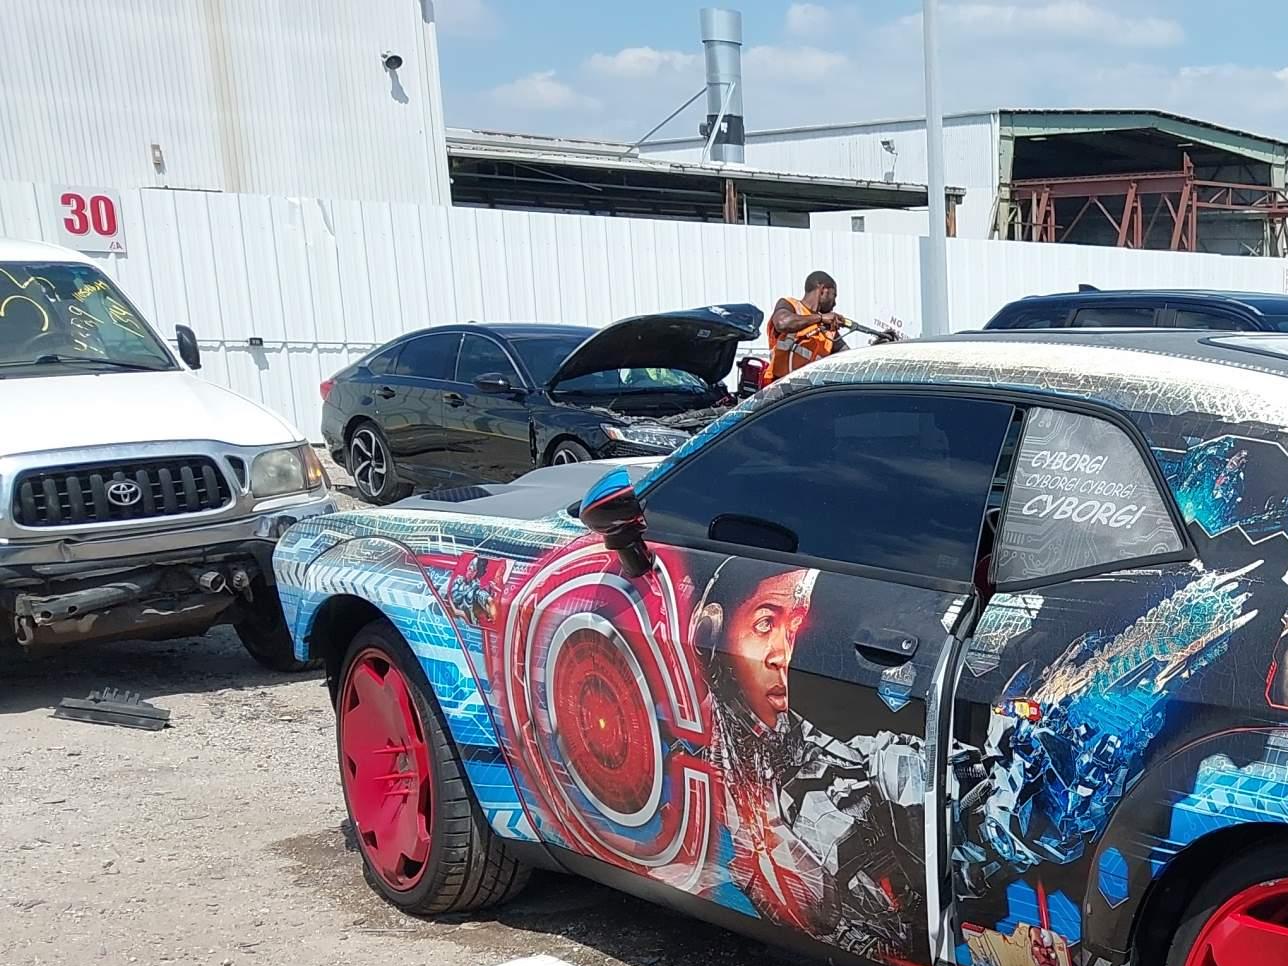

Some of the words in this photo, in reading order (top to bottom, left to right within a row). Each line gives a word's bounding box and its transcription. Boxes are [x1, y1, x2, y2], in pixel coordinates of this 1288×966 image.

[60, 192, 118, 237] 30
[890, 315, 903, 328] NO
[1032, 451, 1108, 474] CYBORG!
[1026, 473, 1081, 491] CYBORG!
[1079, 480, 1137, 499] CYBORG!
[1022, 495, 1146, 529] CYBORG!
